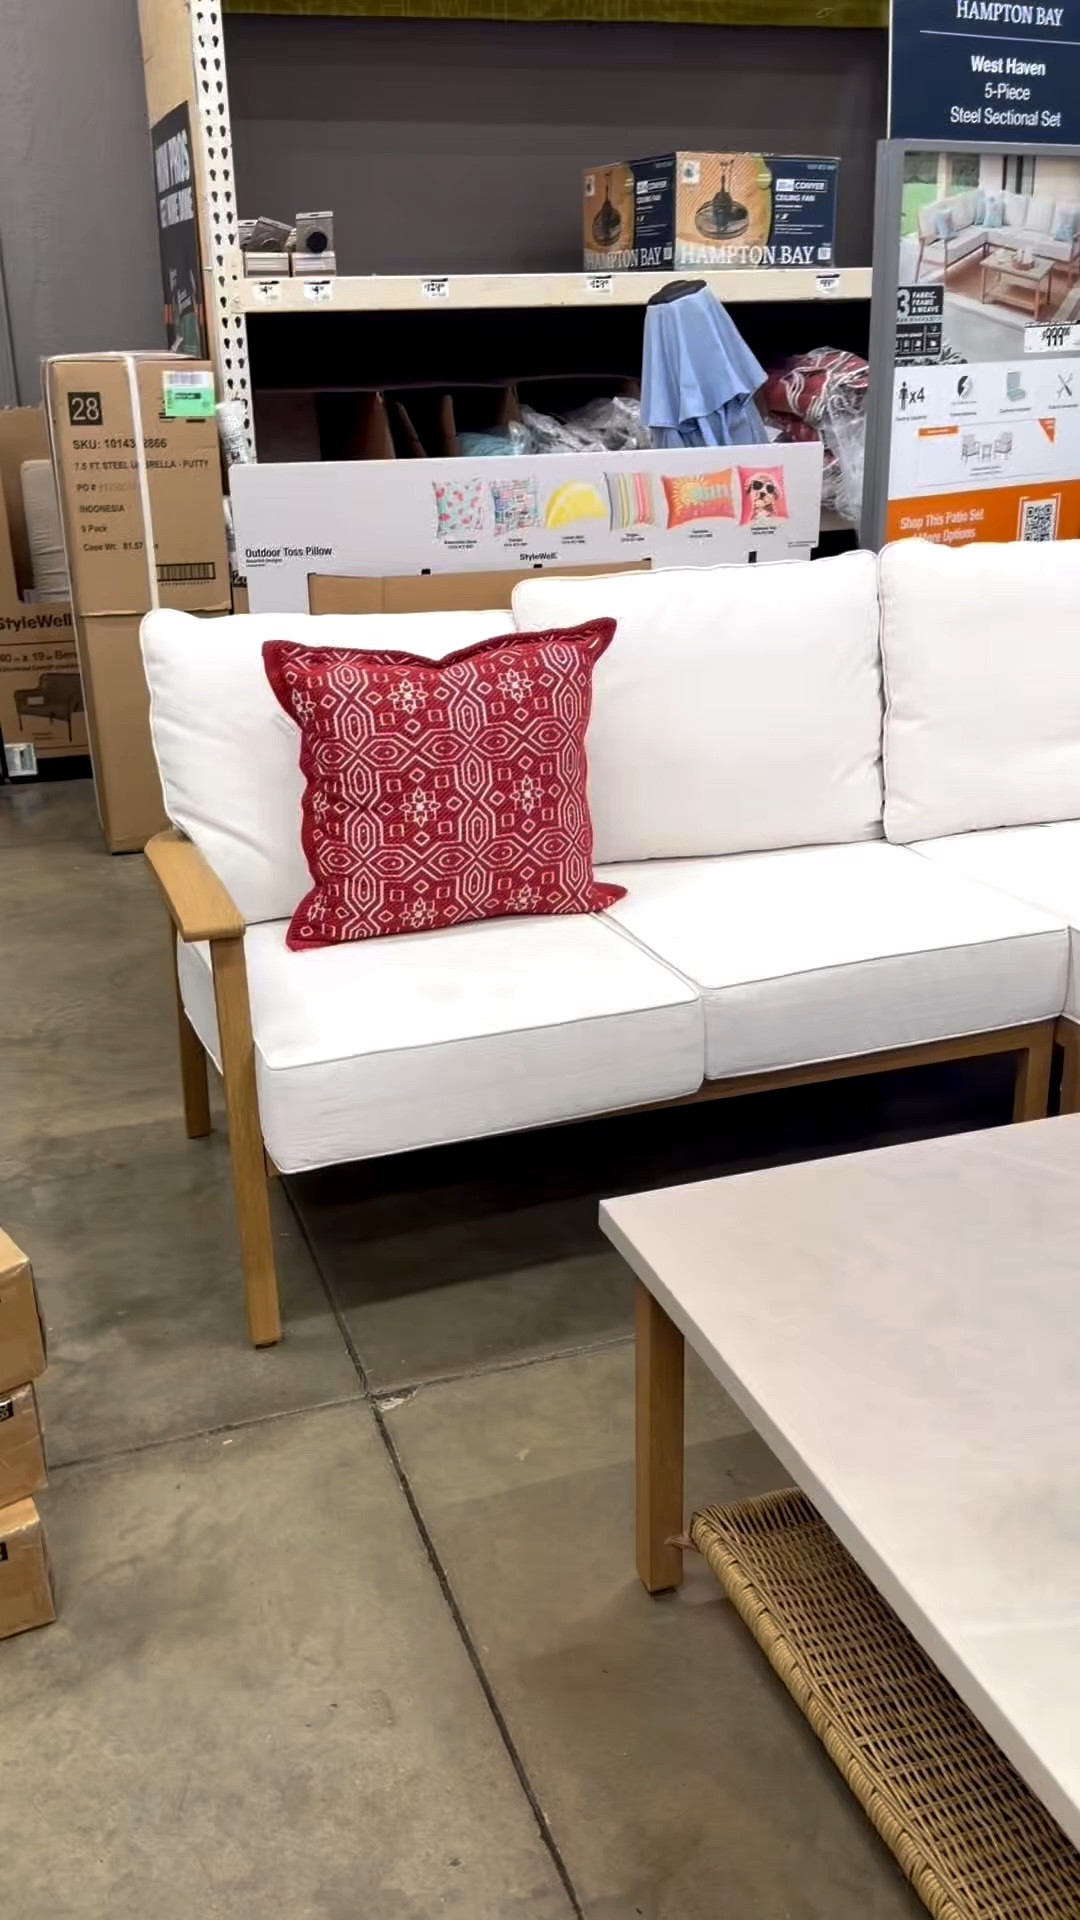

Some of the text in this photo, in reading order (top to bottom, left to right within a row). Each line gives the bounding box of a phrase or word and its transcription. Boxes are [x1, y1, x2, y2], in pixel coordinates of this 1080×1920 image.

[956, 0, 1064, 27] HAMPTON BAY
[971, 55, 1046, 77] West Haven
[984, 82, 1031, 101] 5-Piece
[950, 105, 1062, 127] Steel Sectional Set
[640, 246, 662, 266] BAY
[680, 245, 815, 265] HAMPTON BAY
[909, 387, 925, 403] x4
[70, 397, 100, 421] 28
[72, 439, 100, 450] SKU:
[79, 504, 125, 513] INDONESIA
[900, 508, 985, 531] Shop This Patio Set
[943, 528, 976, 543] Options
[245, 546, 333, 558] Outdoor Toss Pillow
[519, 552, 558, 561] StyleWell
[0, 613, 72, 632] StyleWell
